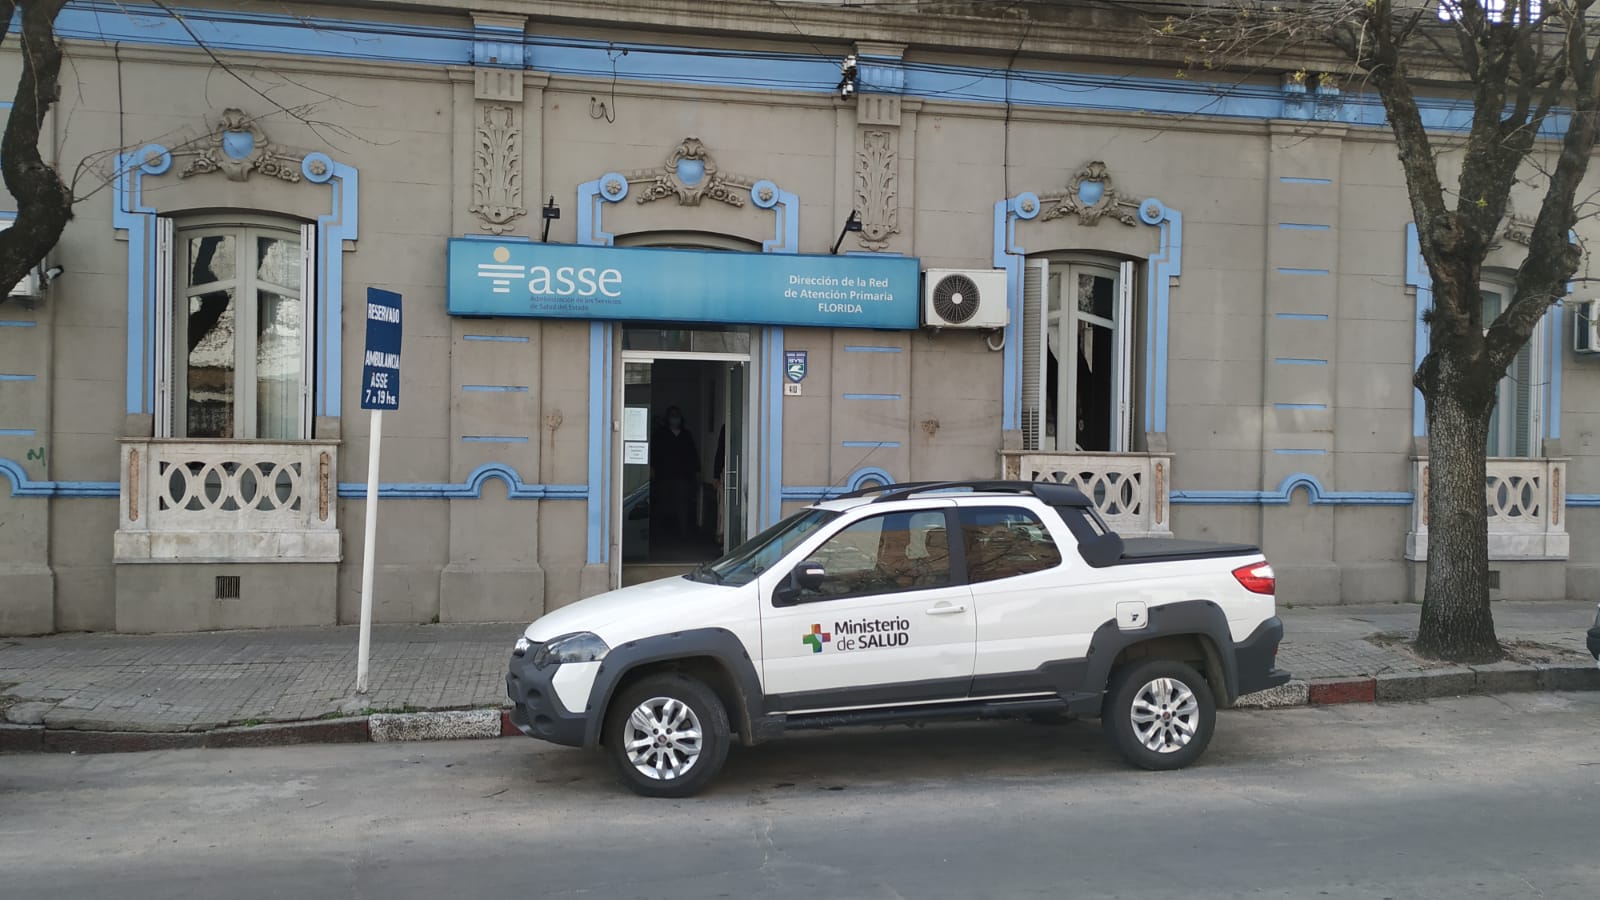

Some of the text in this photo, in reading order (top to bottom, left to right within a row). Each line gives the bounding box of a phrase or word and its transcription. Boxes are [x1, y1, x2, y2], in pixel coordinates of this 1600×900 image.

[528, 265, 622, 297] asse
[789, 274, 889, 288] Dirección de la Red
[784, 288, 893, 301] de Atención Primaria
[368, 303, 400, 323] RESERVADO
[818, 302, 863, 314] FLORIDA
[365, 350, 400, 369] AMBULANCIA
[370, 372, 388, 388] ASSE
[365, 389, 372, 403] 7
[377, 389, 386, 404] 19
[386, 390, 398, 405] hs.
[834, 616, 910, 635] Ministerio
[837, 632, 909, 651] de SALUD
